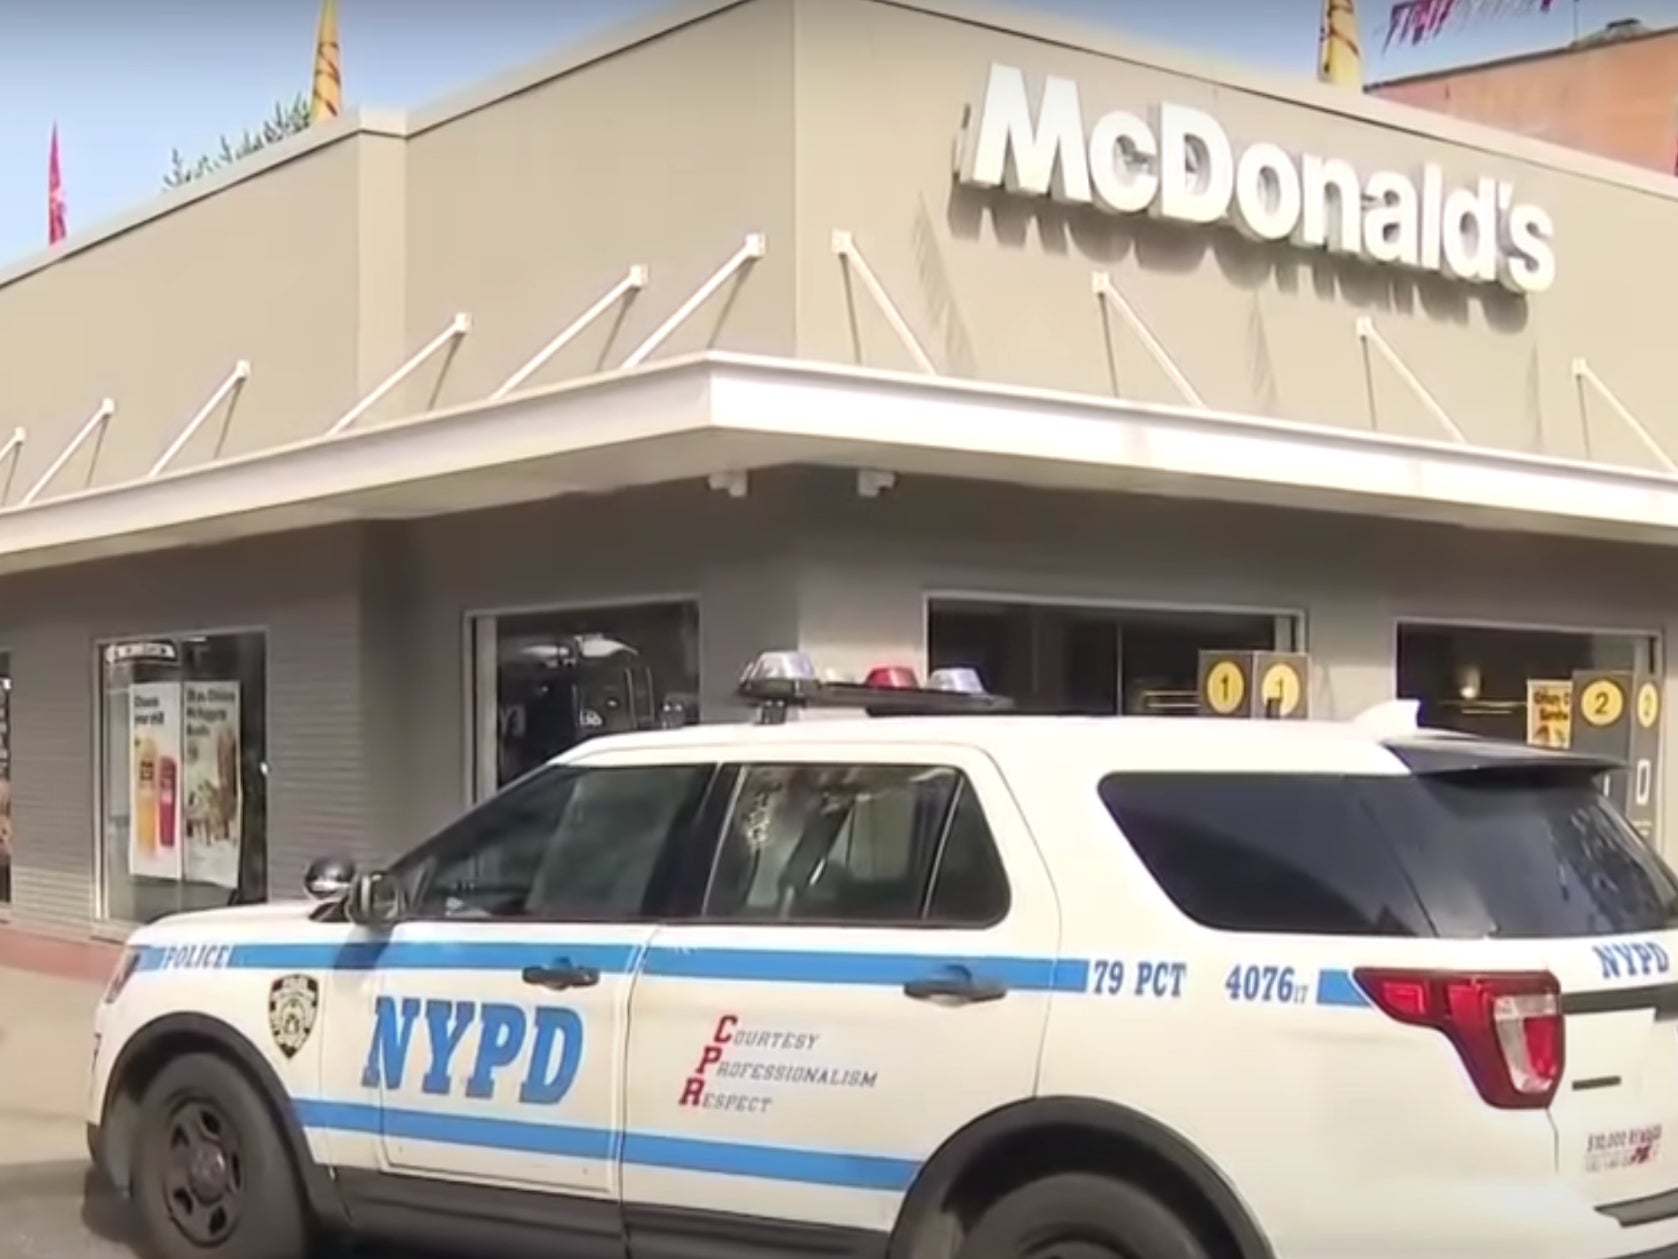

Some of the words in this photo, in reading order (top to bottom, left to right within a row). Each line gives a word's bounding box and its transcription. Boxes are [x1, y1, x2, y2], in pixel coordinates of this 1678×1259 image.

[966, 62, 1556, 294] McDonald's
[1594, 691, 1610, 715] 2
[163, 944, 230, 970] POLICE
[1592, 941, 1670, 979] NYPD
[1093, 959, 1125, 995] 79
[1134, 961, 1188, 998] PCT
[1225, 964, 1295, 1002] 4076
[361, 995, 584, 1106] NYPD
[713, 1014, 820, 1051] COURTESY
[694, 1045, 879, 1088] PROFESSIONALISM
[678, 1077, 773, 1113] RESPECT
